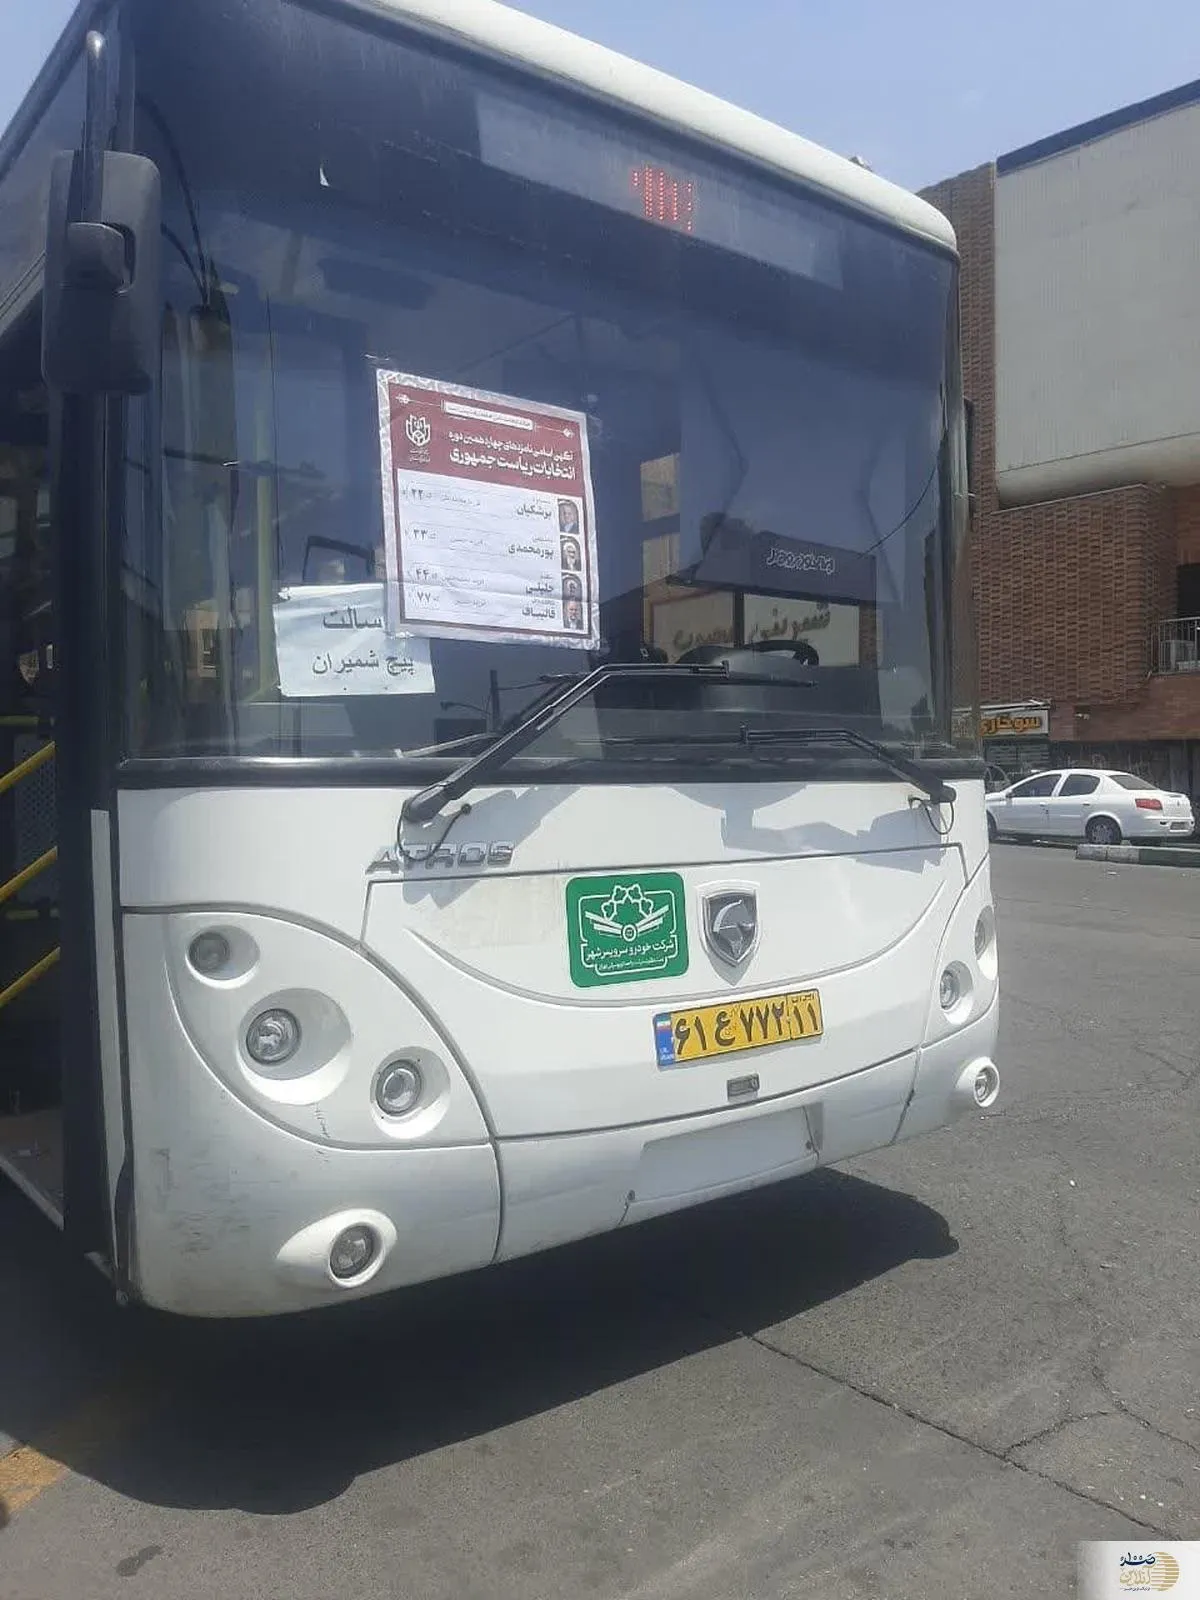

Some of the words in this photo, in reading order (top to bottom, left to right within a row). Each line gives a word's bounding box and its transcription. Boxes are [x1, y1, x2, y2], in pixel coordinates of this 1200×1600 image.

[449, 447, 496, 468] جمهوری
[497, 455, 535, 476] ریاست
[536, 460, 576, 480] انتخابات
[508, 543, 554, 560] پورمحمدی
[417, 591, 431, 603] ۷۷
[322, 606, 384, 629] سالت
[312, 649, 380, 674] شمیران
[385, 655, 415, 676] پیچ
[365, 841, 516, 875] ATROS
[629, 943, 651, 956] خودرو
[652, 938, 675, 953] شرکت
